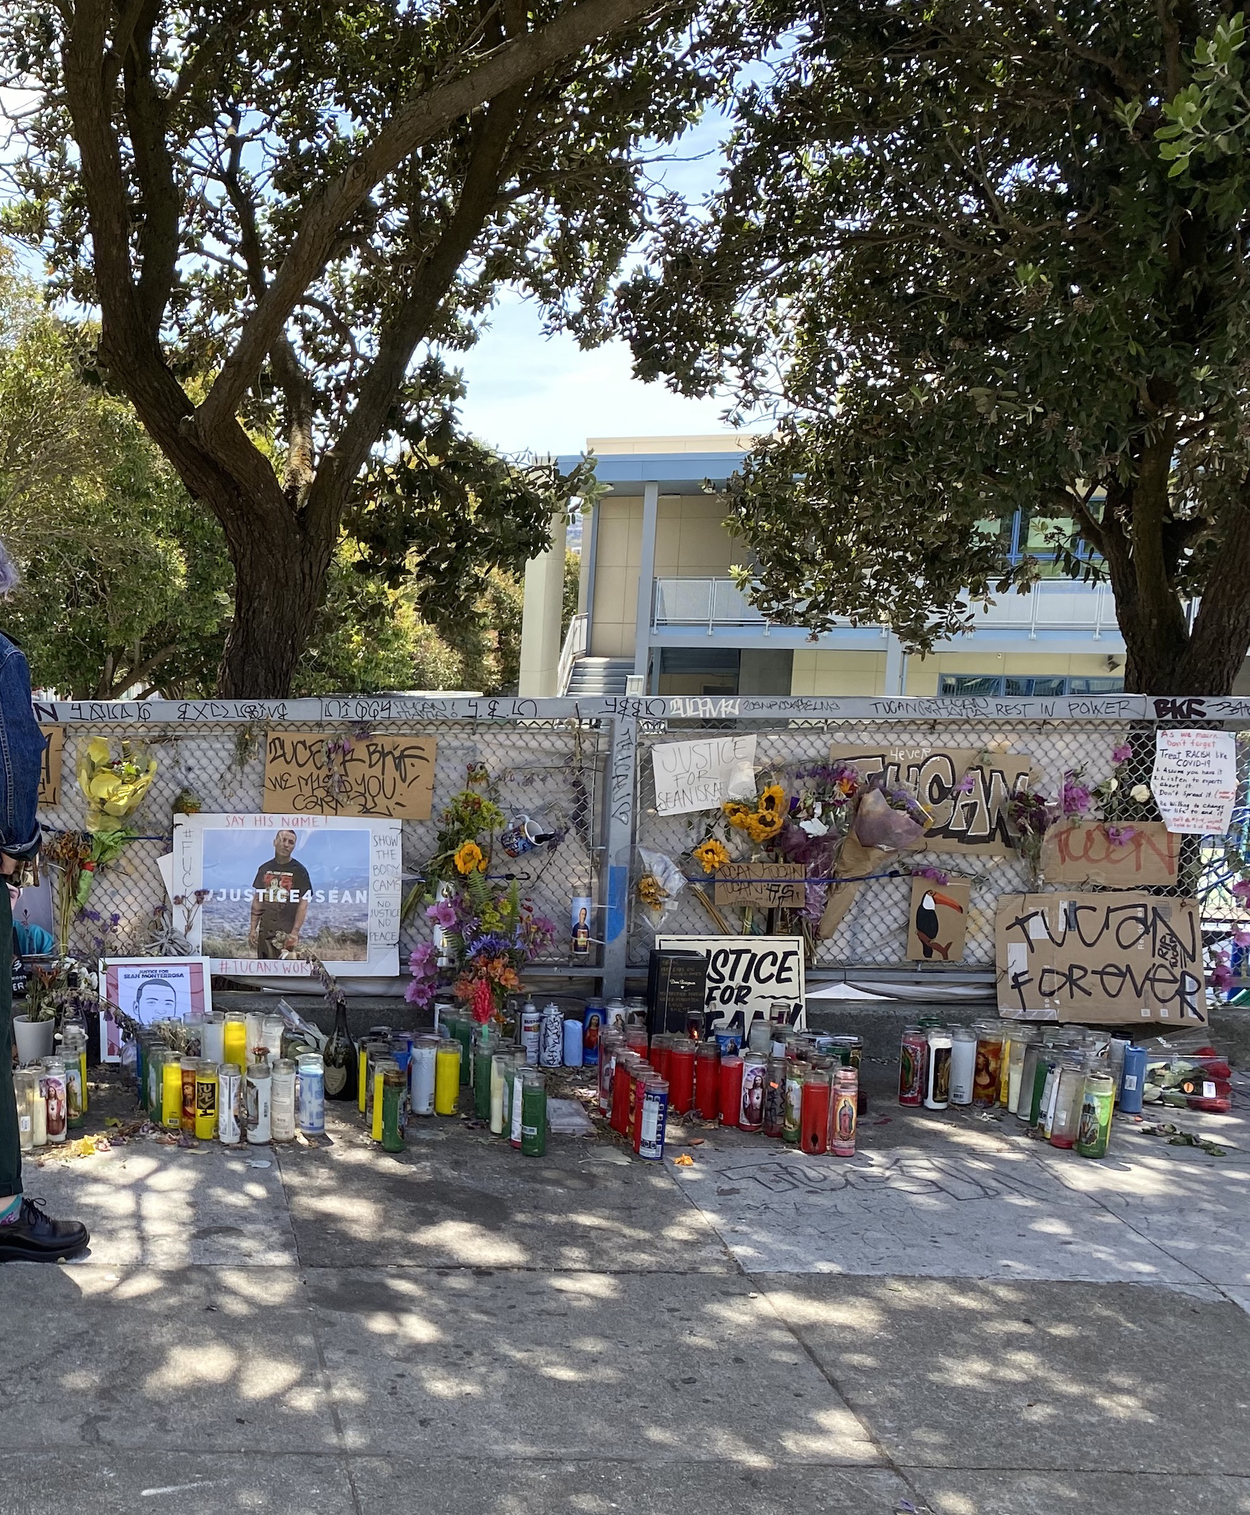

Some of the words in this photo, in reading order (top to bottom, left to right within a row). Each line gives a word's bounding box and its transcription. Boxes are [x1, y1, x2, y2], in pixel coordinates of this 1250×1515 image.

[995, 703, 1035, 717] REST
[1040, 701, 1056, 717] IN
[1068, 699, 1145, 718] POWER
[1166, 739, 1186, 747] Don't
[1190, 739, 1216, 749] forget
[661, 738, 748, 773] JUSTICE
[1160, 749, 1182, 759] Treat
[1185, 750, 1210, 759] RACISM
[1215, 750, 1228, 760] like
[1176, 759, 1211, 768] COVID-19
[267, 772, 296, 791] WE
[672, 769, 719, 787] FOR
[1160, 775, 1188, 783] Listen
[1201, 778, 1223, 787] experts
[657, 788, 694, 811] SEAN
[225, 815, 246, 828] SAY
[254, 815, 273, 827] HIS
[373, 834, 399, 848] SHOW
[376, 849, 397, 860] THE
[372, 863, 401, 877] BODY
[372, 879, 401, 892] CAMS
[377, 900, 391, 908] NO
[369, 908, 401, 918] JUSTICE
[377, 918, 392, 928] NO
[369, 931, 397, 942] PEACE
[705, 984, 753, 1006] FOR
